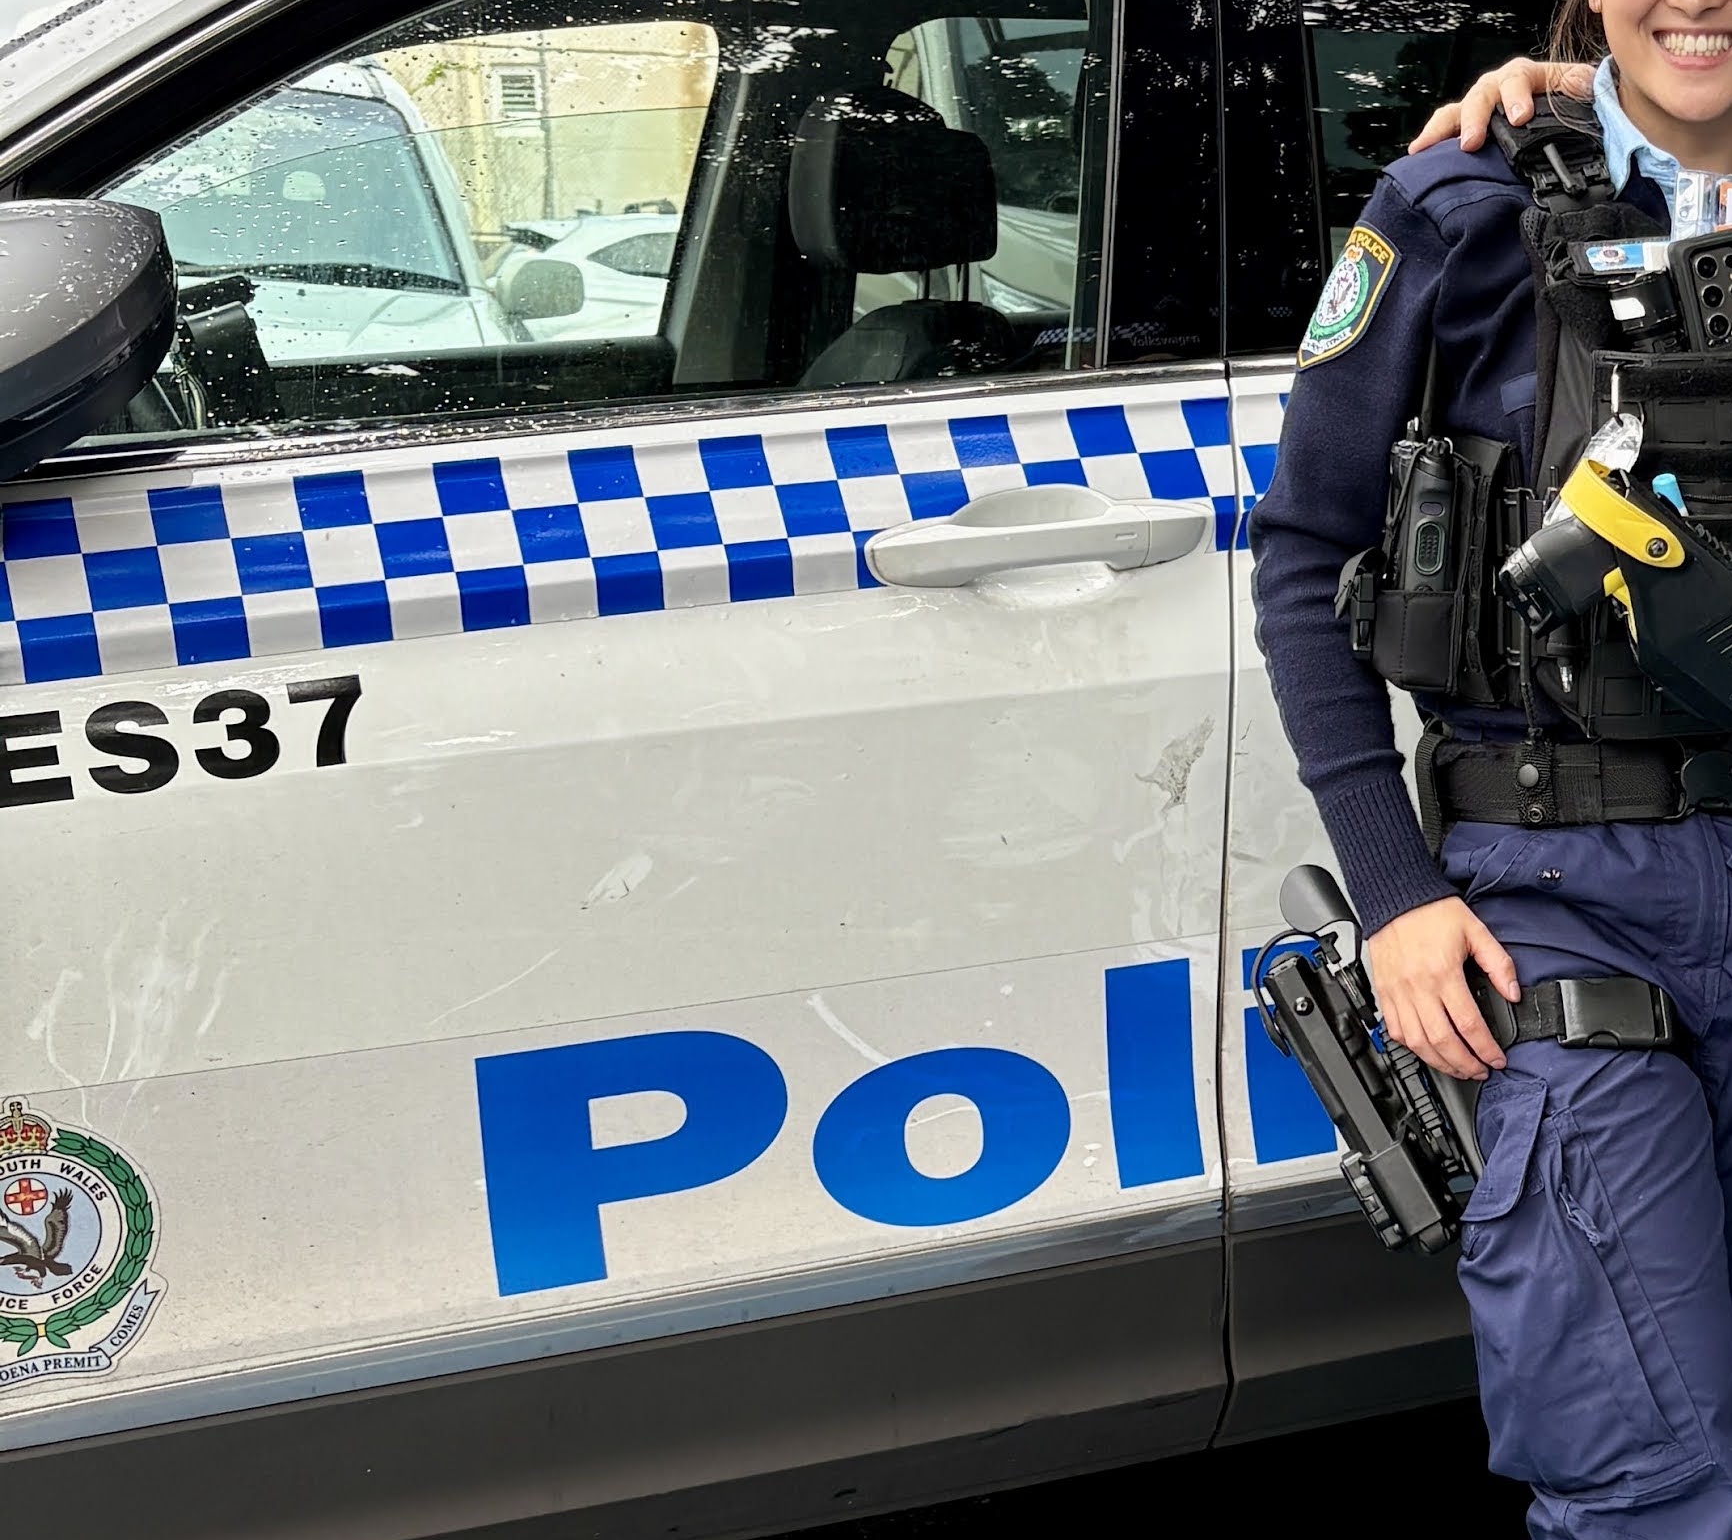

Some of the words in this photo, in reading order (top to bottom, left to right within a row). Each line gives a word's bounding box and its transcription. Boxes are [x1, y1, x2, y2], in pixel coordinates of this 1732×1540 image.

[1356, 232, 1389, 265] POLICE
[476, 939, 1384, 1298] Poli
[60, 1163, 108, 1202] WALES
[51, 1264, 104, 1304] FORCE
[43, 1355, 103, 1371] PREMIT
[110, 1304, 144, 1347] COMES
